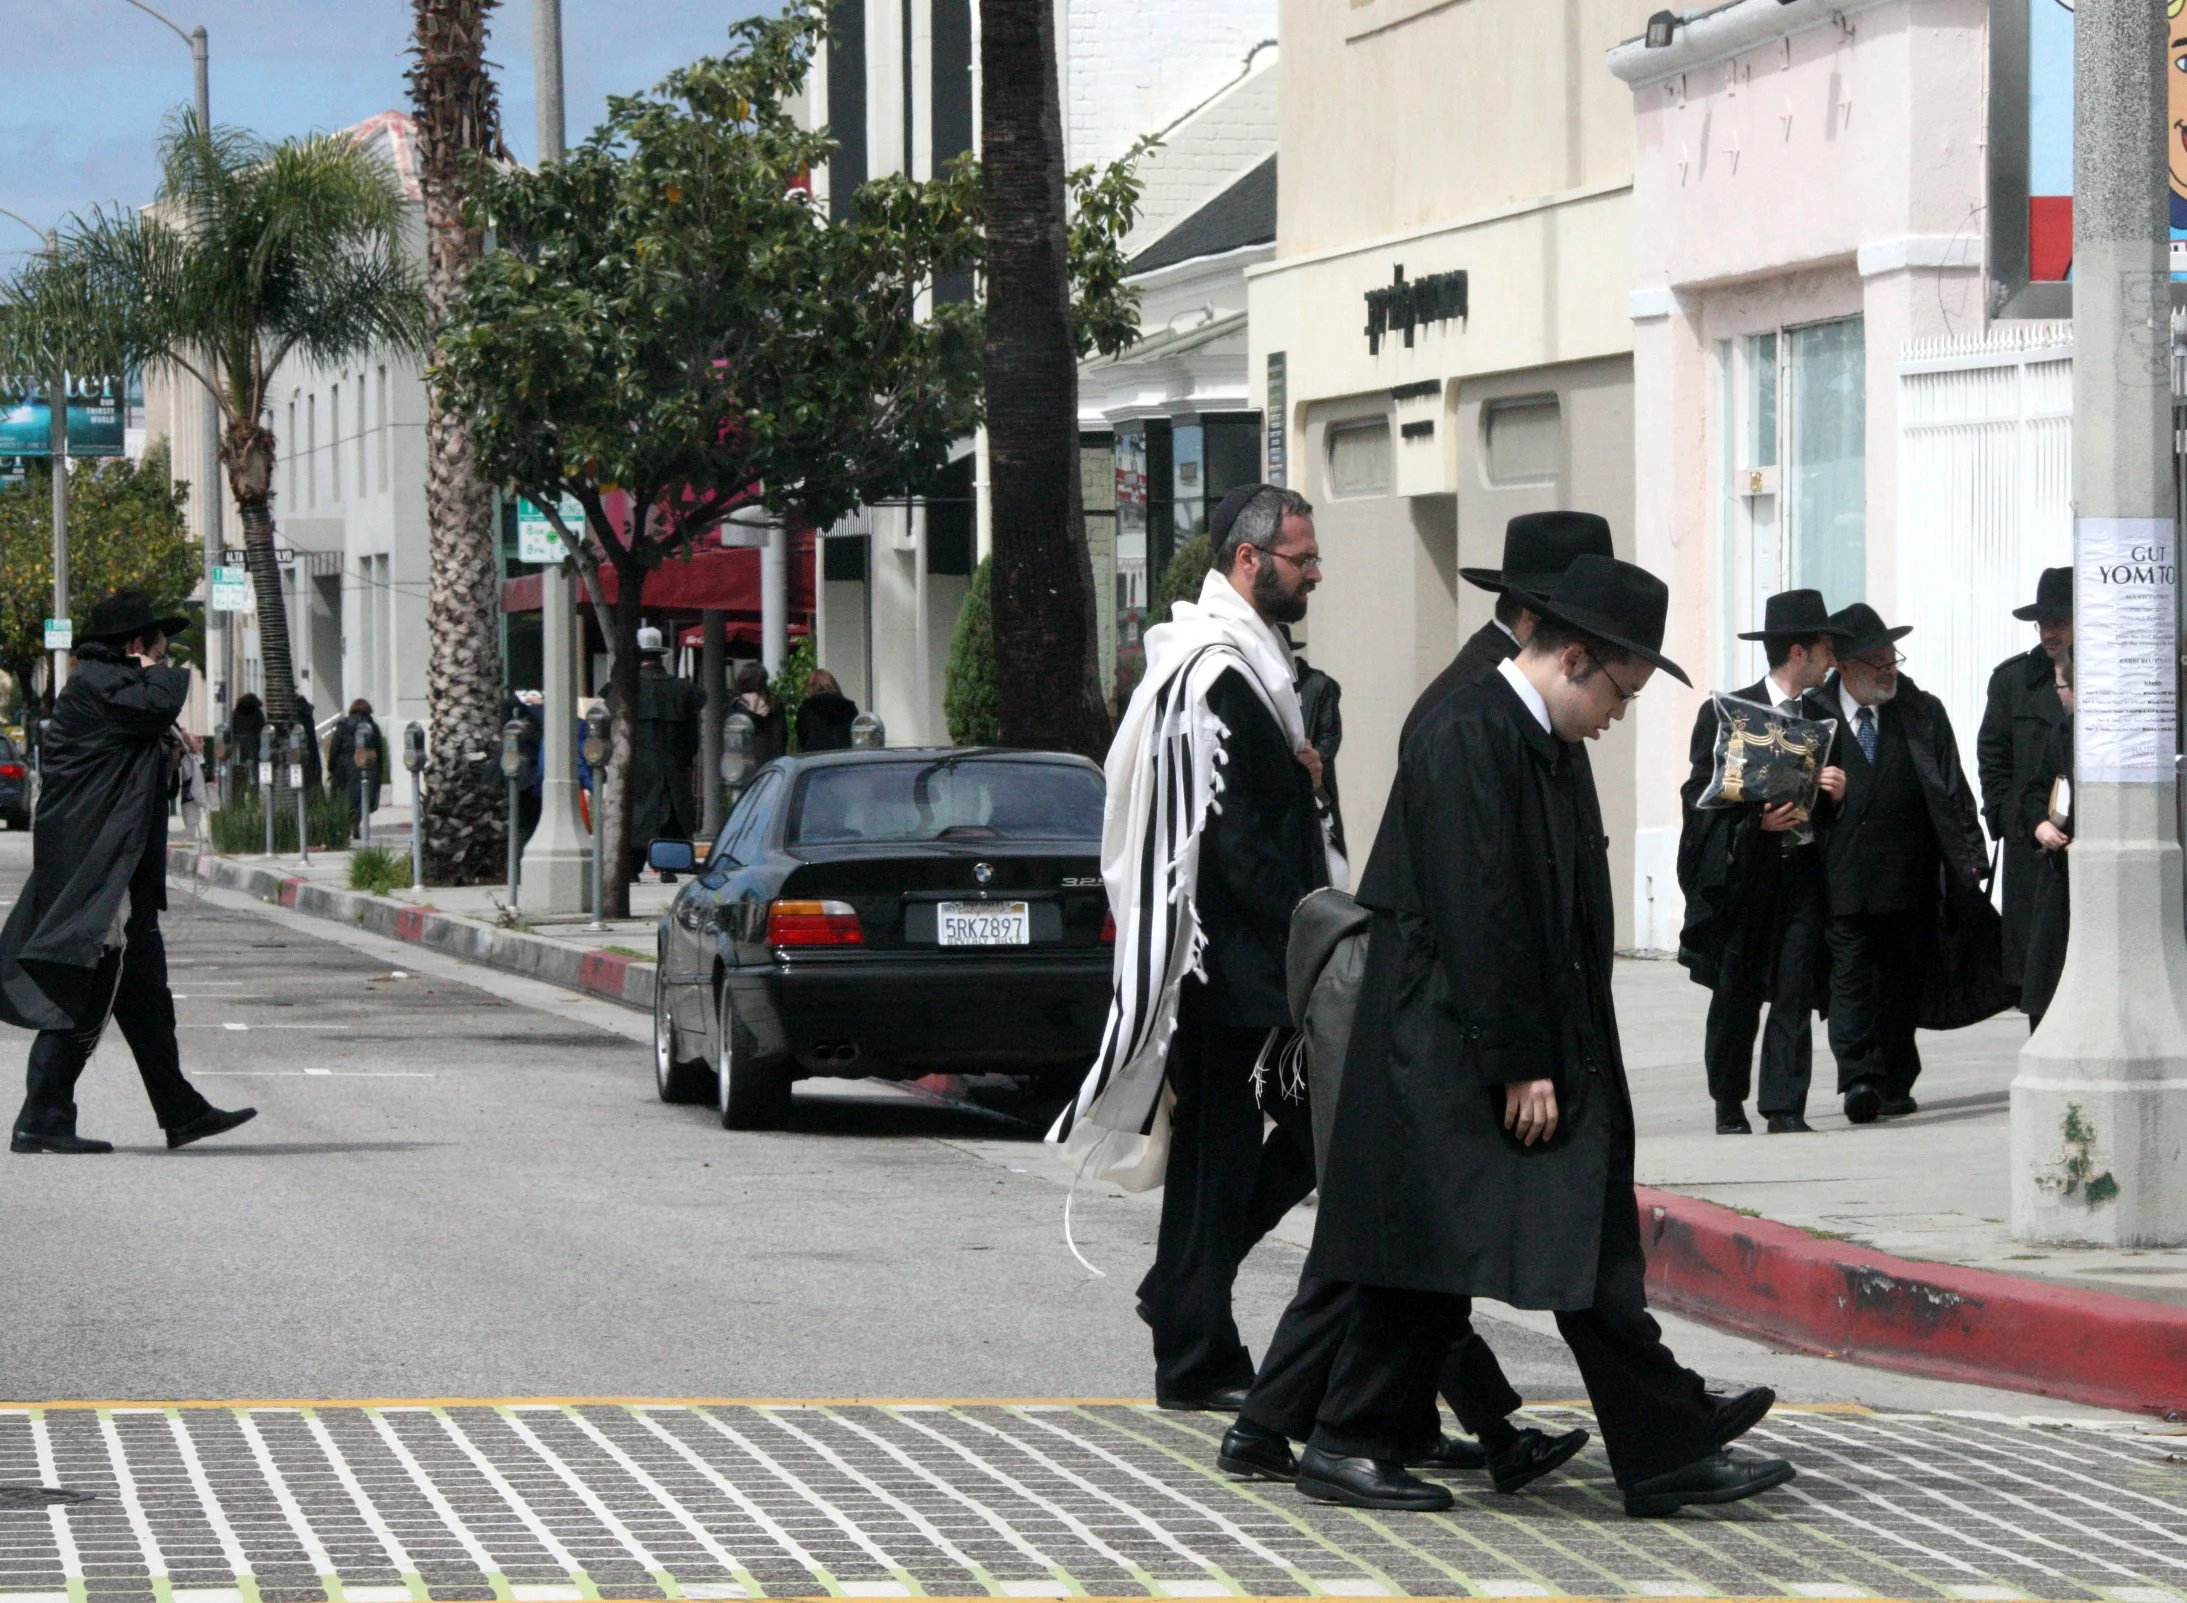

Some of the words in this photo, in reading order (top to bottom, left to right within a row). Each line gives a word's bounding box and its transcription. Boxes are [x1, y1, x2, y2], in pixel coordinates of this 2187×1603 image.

[100, 398, 115, 406] OUR
[86, 407, 115, 415] THIRSTY
[90, 415, 116, 424] WORLD
[226, 551, 244, 562] ALTA
[2131, 546, 2165, 562] GUT
[2099, 565, 2154, 585] YOM
[945, 917, 1022, 938] 5RKZ897
